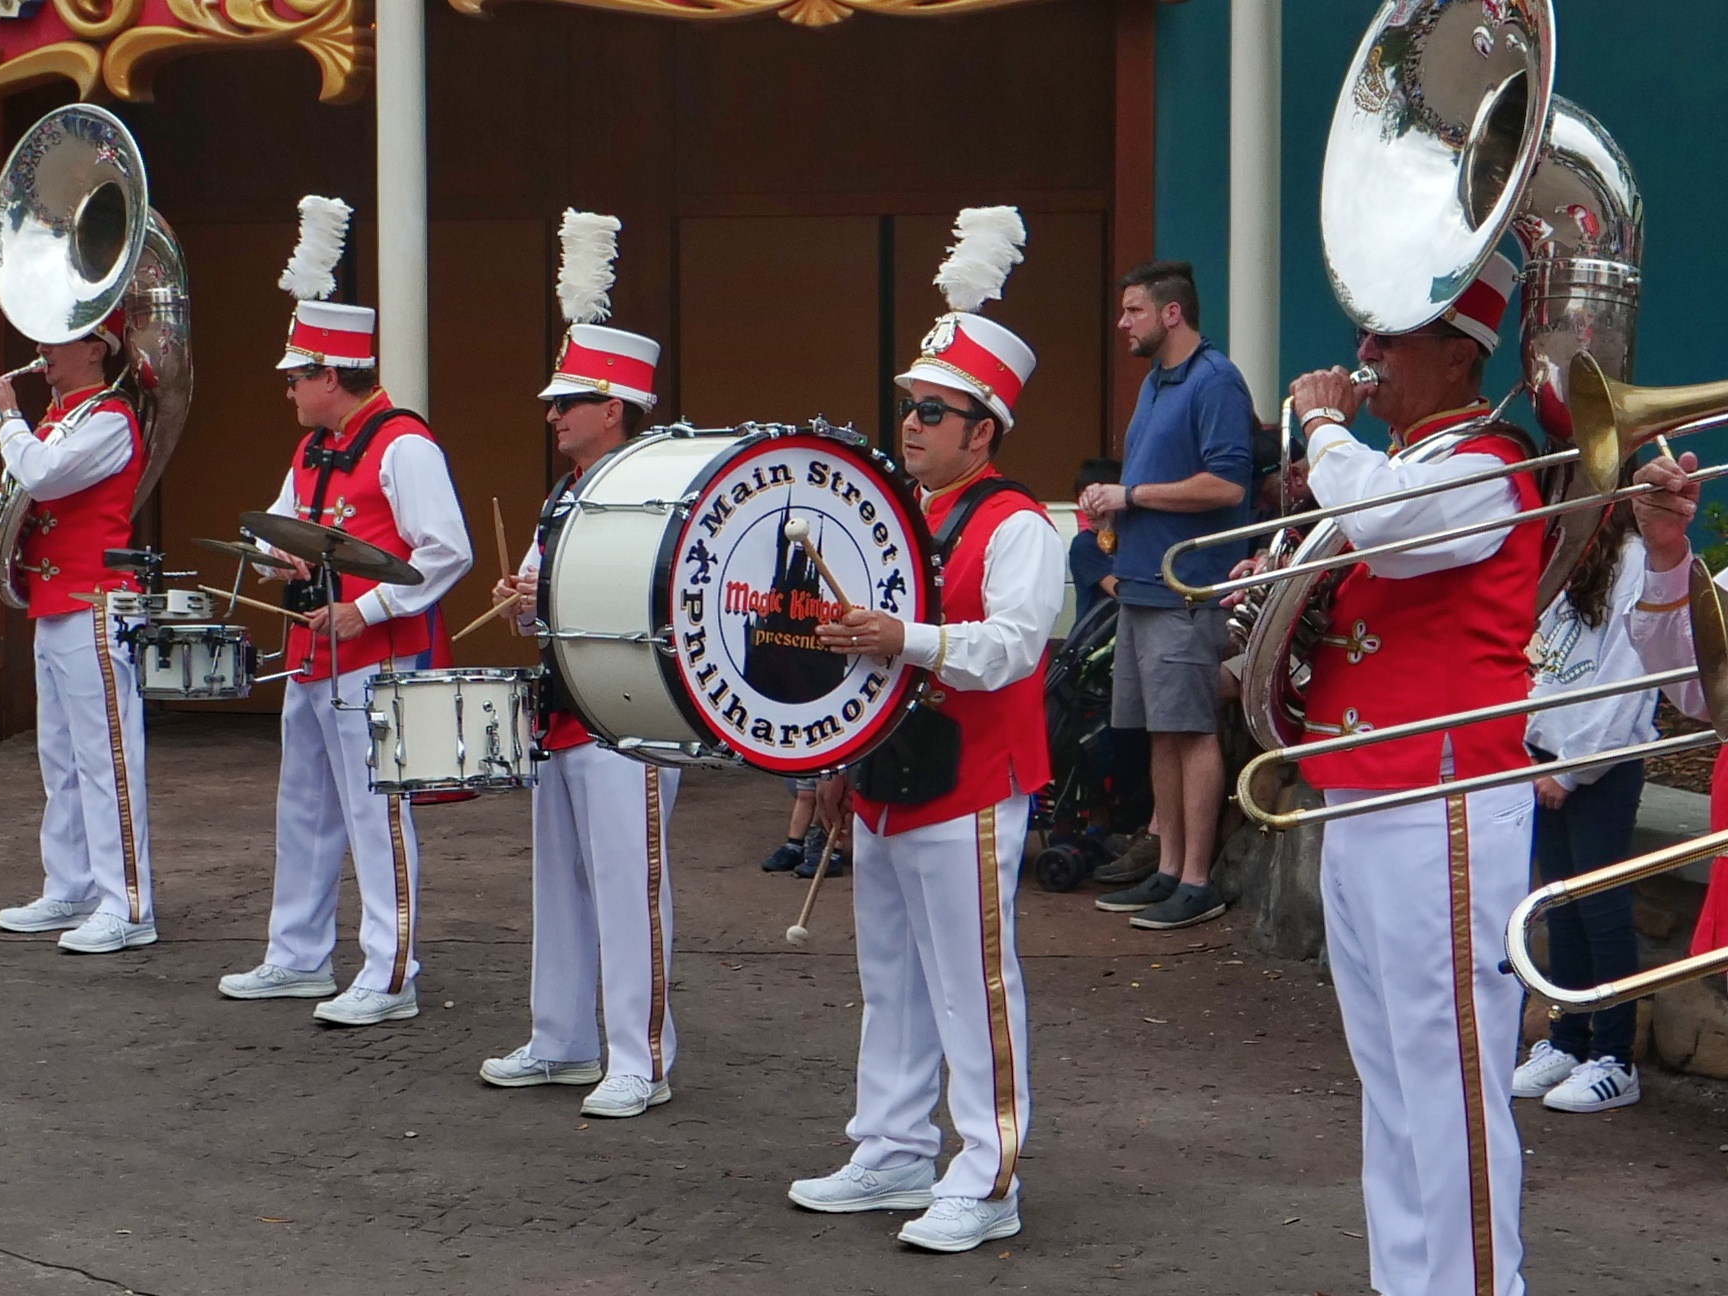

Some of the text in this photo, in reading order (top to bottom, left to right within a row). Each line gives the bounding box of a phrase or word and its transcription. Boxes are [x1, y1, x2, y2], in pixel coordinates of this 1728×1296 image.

[698, 460, 900, 567] Main Street
[725, 580, 784, 618] Magic
[680, 588, 896, 750] Philharmon
